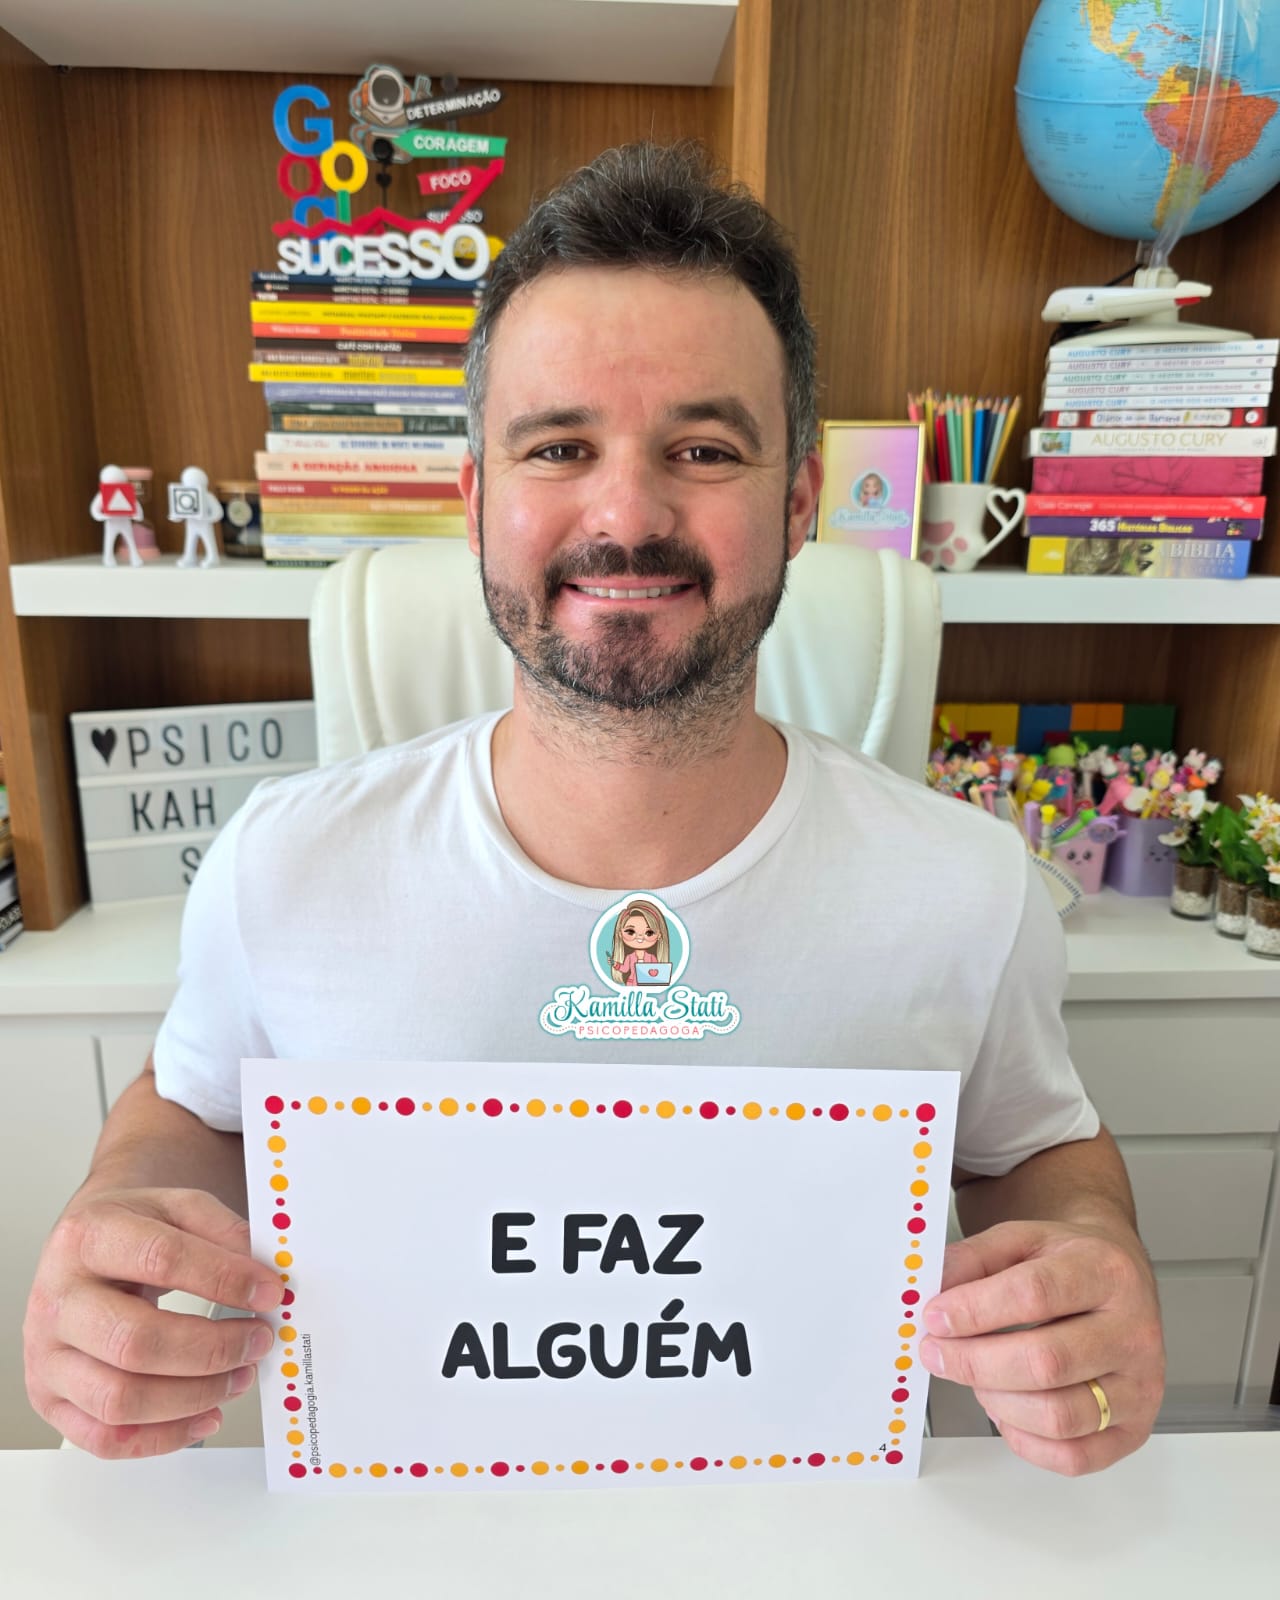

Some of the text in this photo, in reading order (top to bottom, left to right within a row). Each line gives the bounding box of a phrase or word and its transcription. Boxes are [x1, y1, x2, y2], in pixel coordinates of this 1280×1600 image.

[406, 89, 501, 121] DETERMINAÇÃO
[413, 135, 489, 154] CORAGEM
[429, 171, 472, 191] FOCO
[278, 224, 489, 281] SUCESSO
[1067, 362, 1107, 370] AUGUSTO
[1109, 361, 1132, 369] CURY
[1063, 374, 1102, 382] AUGUSTO
[1104, 373, 1128, 382] CURY
[1067, 386, 1105, 394] AUGUSTO
[1108, 385, 1130, 393] CURY
[1091, 432, 1227, 447] AUGUSTO CURY
[1089, 518, 1116, 532] 365
[128, 719, 283, 768] PSICO
[131, 787, 216, 831] KAH
[491, 1211, 705, 1275] E FAZ
[441, 1297, 752, 1380] ALGUÉM
[301, 1333, 322, 1466] @psicopedagogia.kamillastati
[879, 1442, 887, 1453] 4
